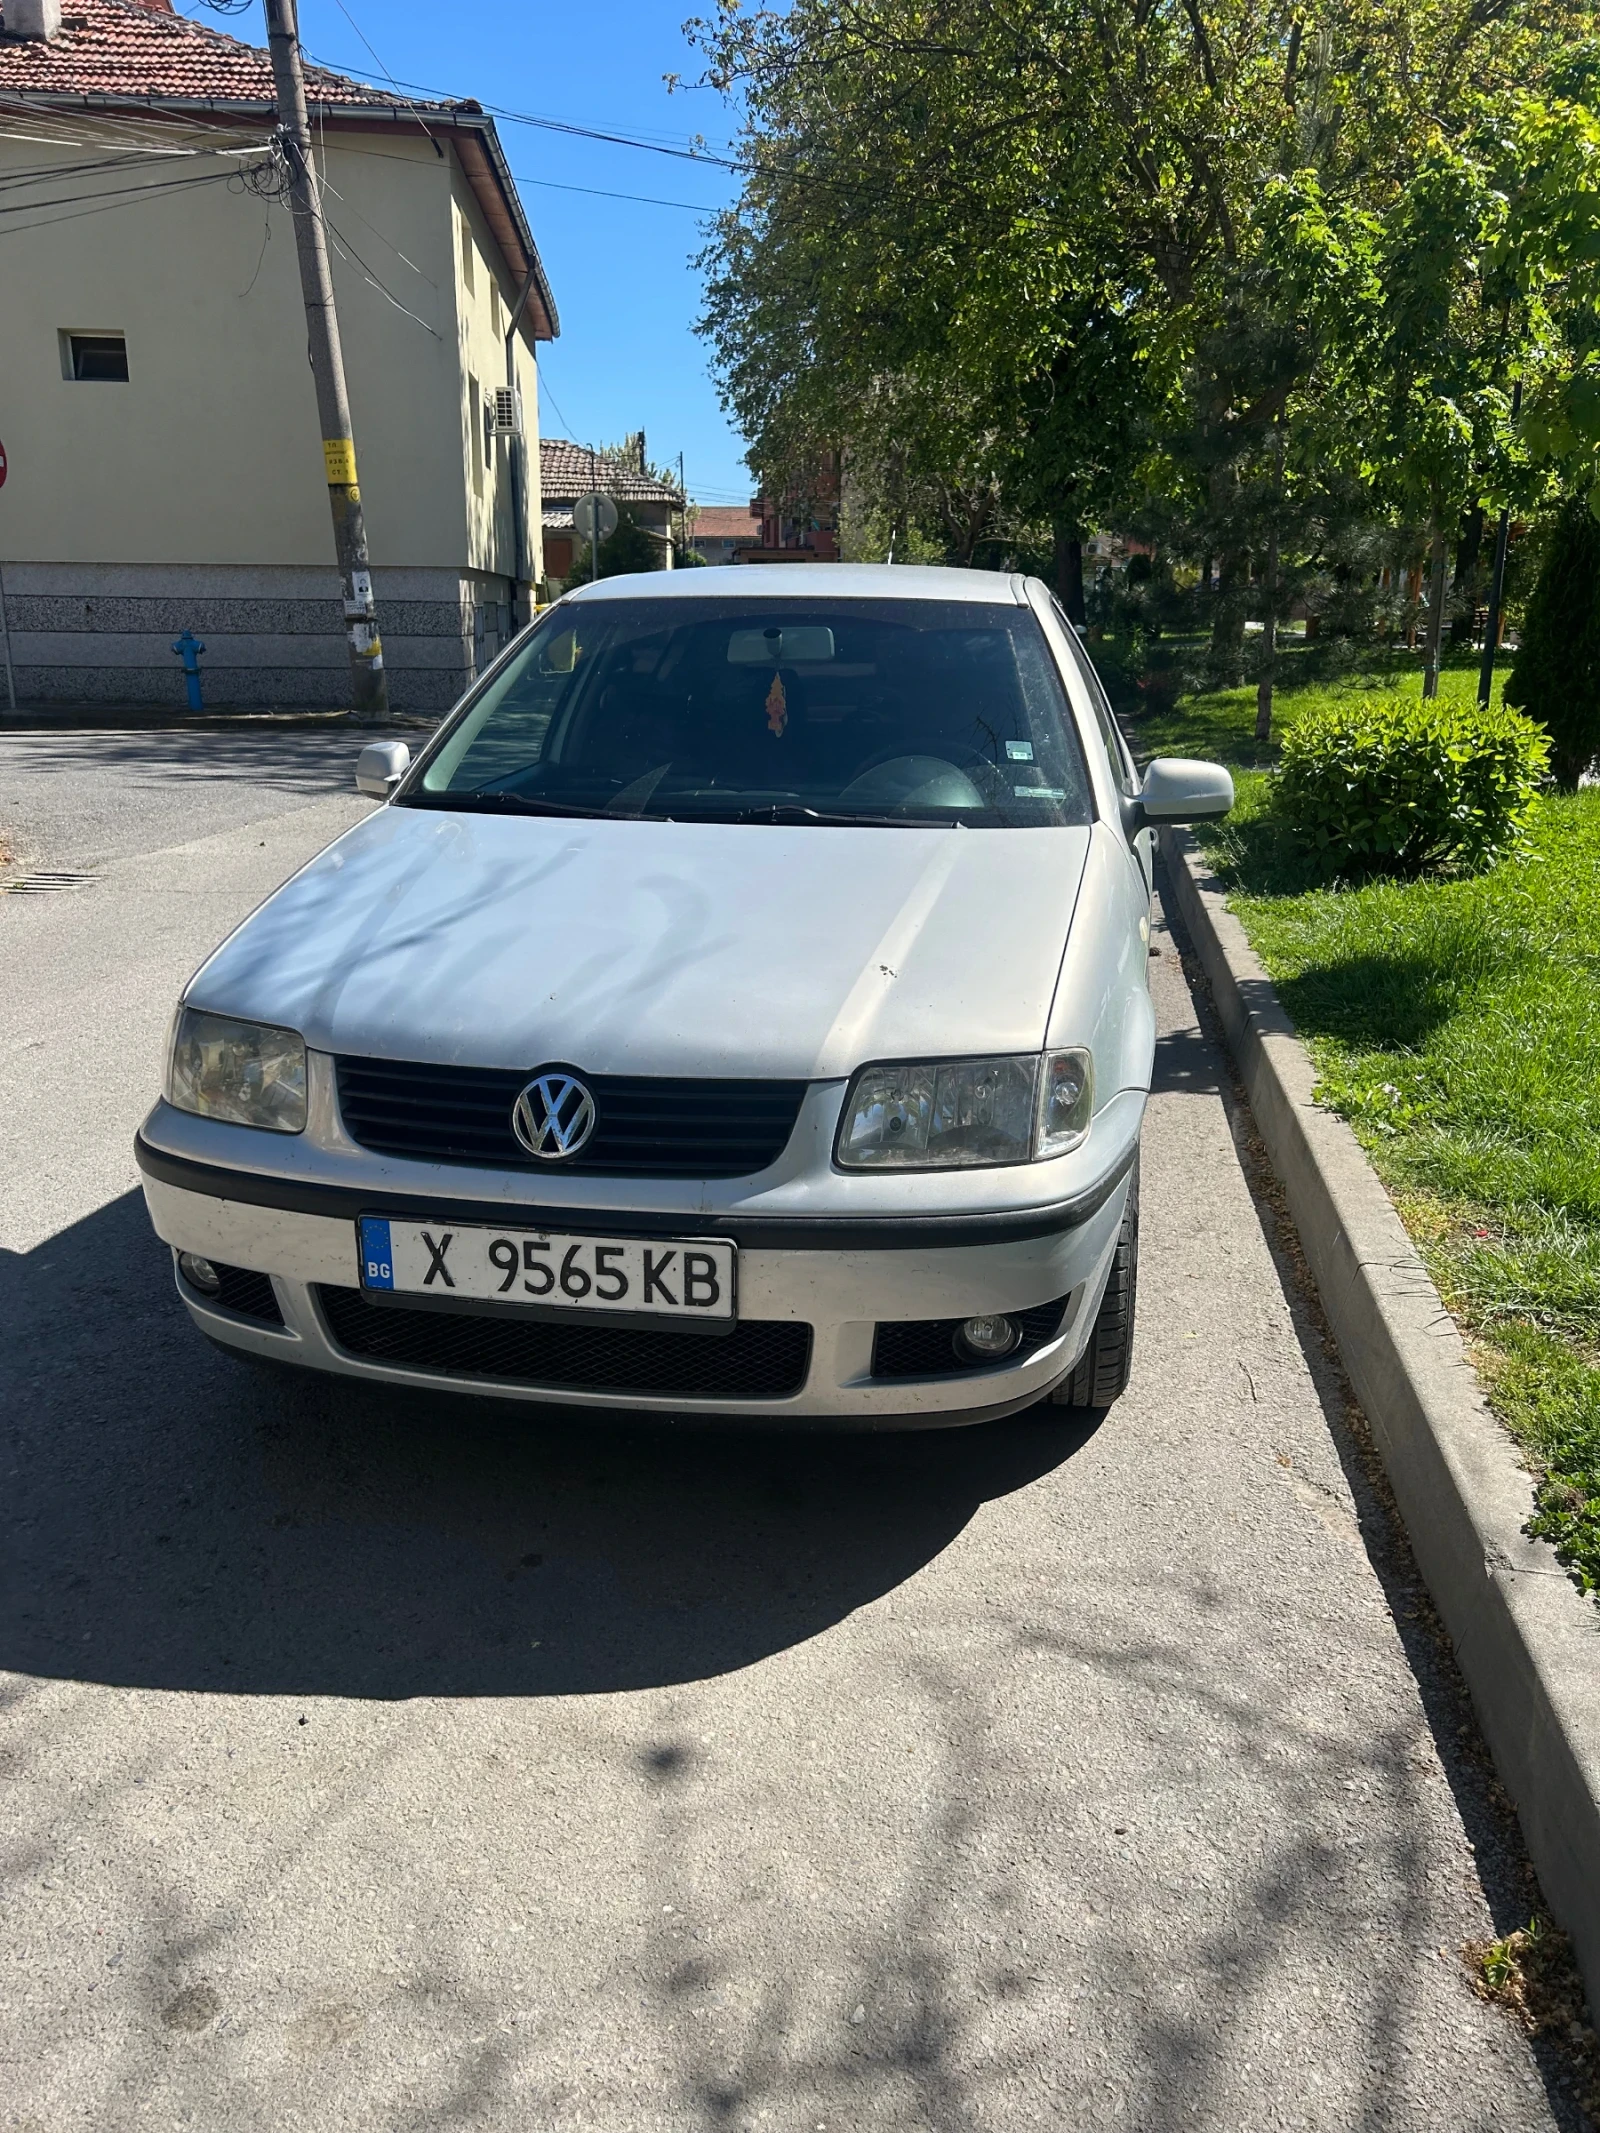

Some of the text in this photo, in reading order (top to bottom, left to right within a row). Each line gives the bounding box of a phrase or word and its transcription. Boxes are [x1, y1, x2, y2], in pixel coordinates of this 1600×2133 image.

[367, 1261, 391, 1279] BG
[420, 1231, 720, 1308] X 9565 KB
